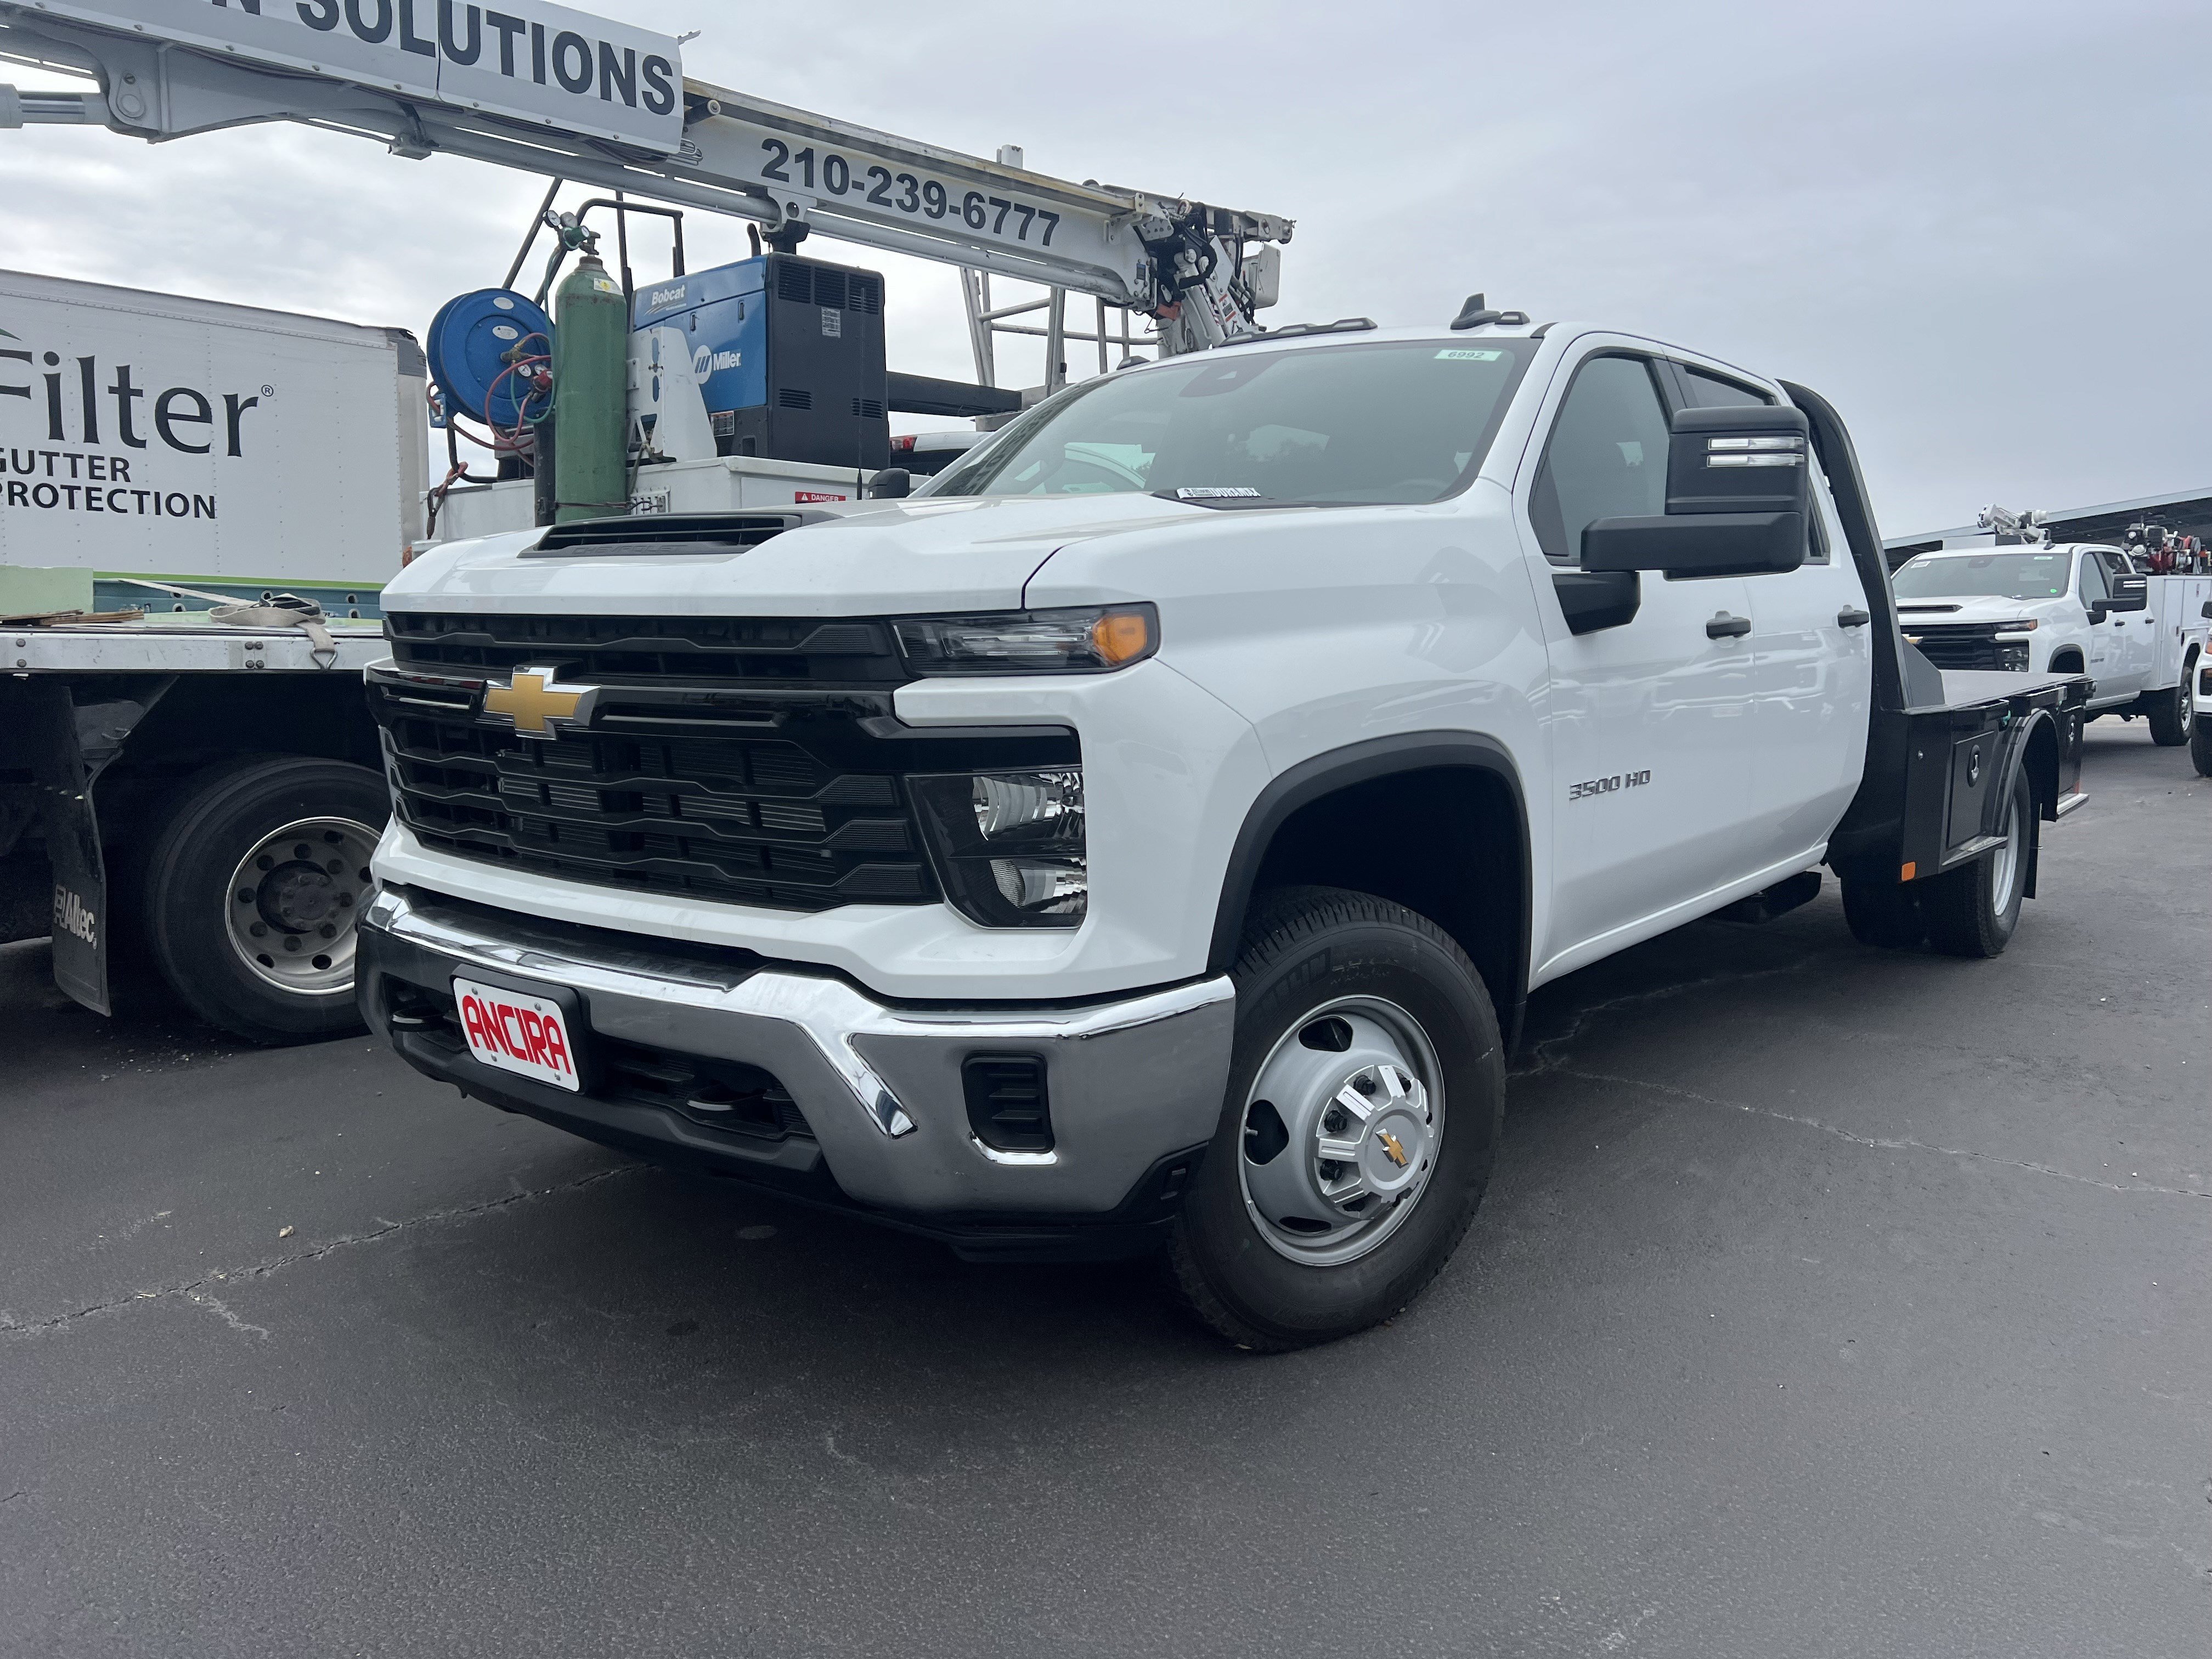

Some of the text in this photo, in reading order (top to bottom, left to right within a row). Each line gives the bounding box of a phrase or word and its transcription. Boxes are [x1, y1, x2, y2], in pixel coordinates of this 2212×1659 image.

[760, 138, 1060, 246] 210-239-6777
[651, 284, 686, 306] Bobcat
[713, 351, 741, 371] Miller
[0, 448, 131, 482] UTTER
[0, 480, 216, 519] ROTECTION
[1569, 770, 1651, 801] 3500 HD
[462, 995, 572, 1075] ANCIRA
